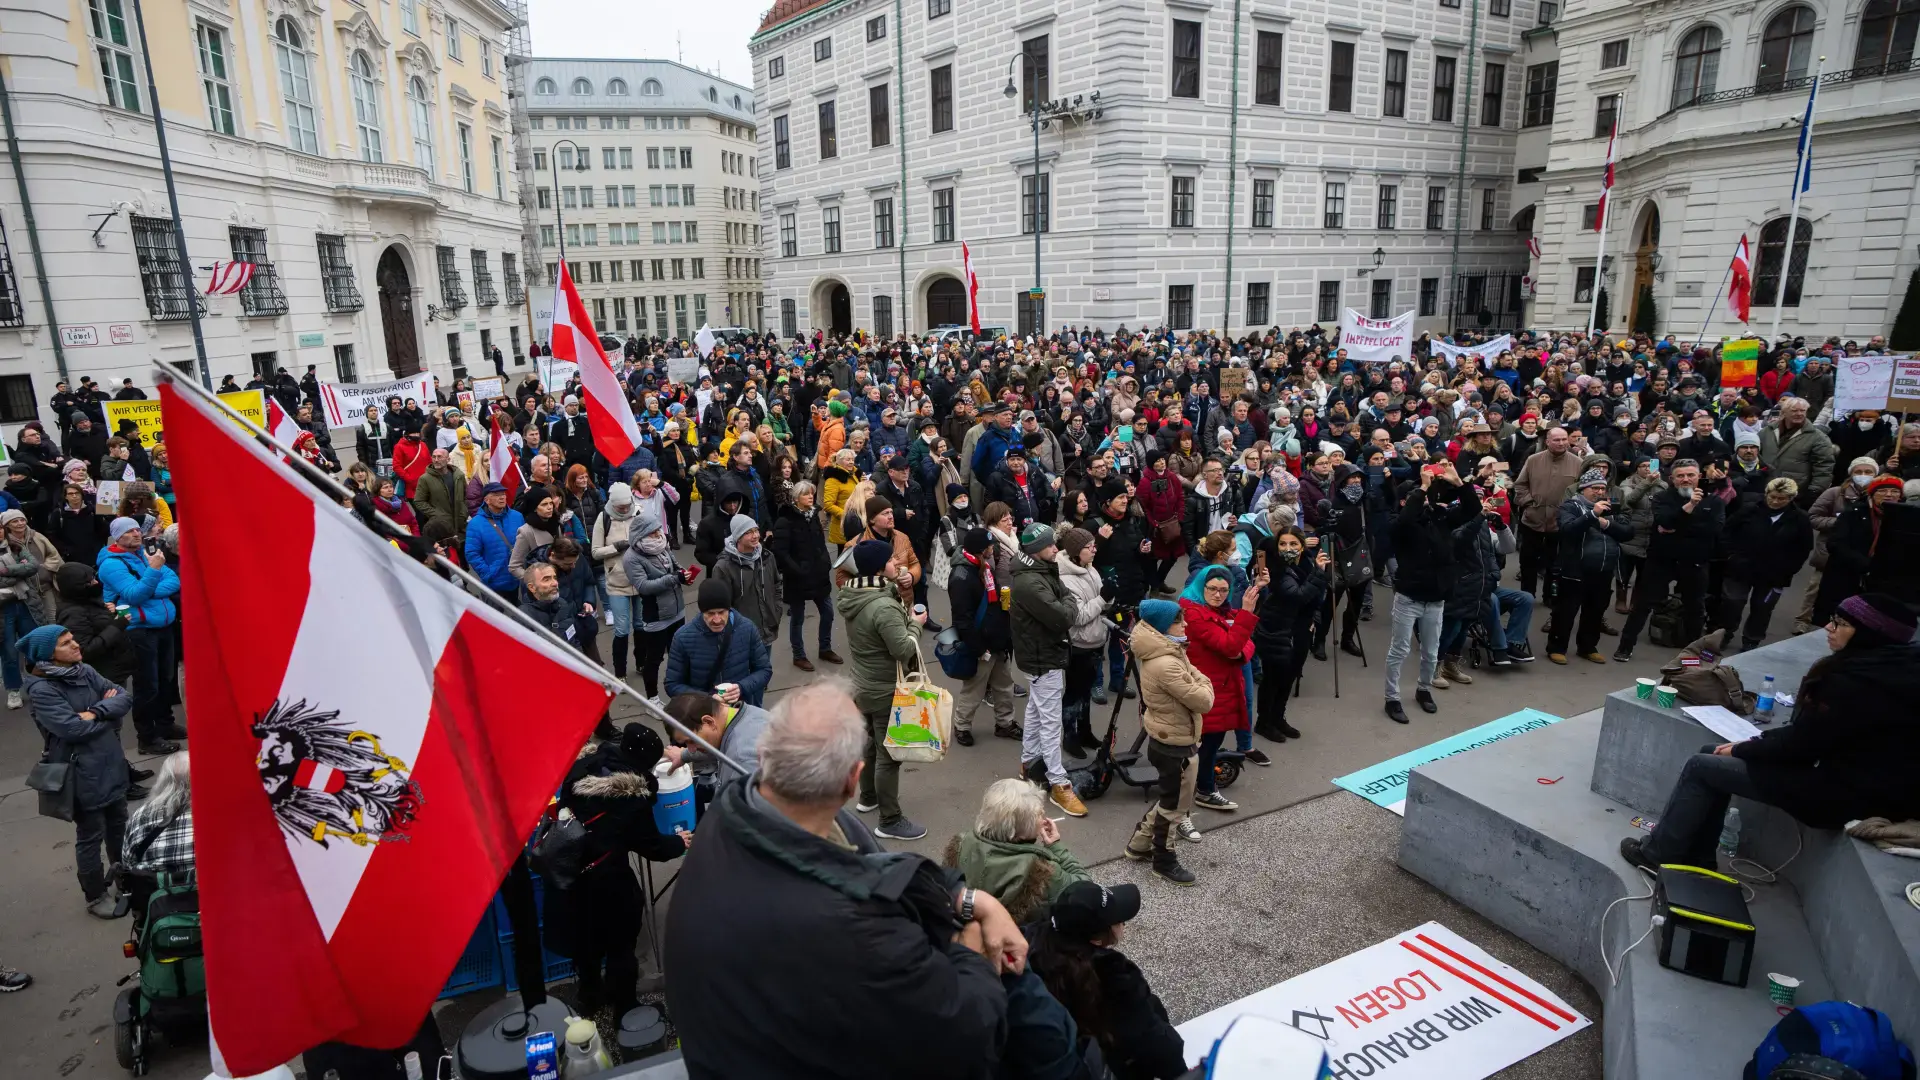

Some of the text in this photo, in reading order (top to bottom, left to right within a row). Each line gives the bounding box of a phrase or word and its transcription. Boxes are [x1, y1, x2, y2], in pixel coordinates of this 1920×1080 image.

[1356, 316, 1393, 329] NEIN
[1345, 333, 1404, 347] IMPFPFLICHT
[342, 388, 359, 398] DER
[361, 386, 387, 396] FISCH
[362, 396, 376, 406] AM
[112, 406, 131, 415] WIR
[1335, 969, 1443, 1030] LOGEN
[1434, 996, 1502, 1031] WIR
